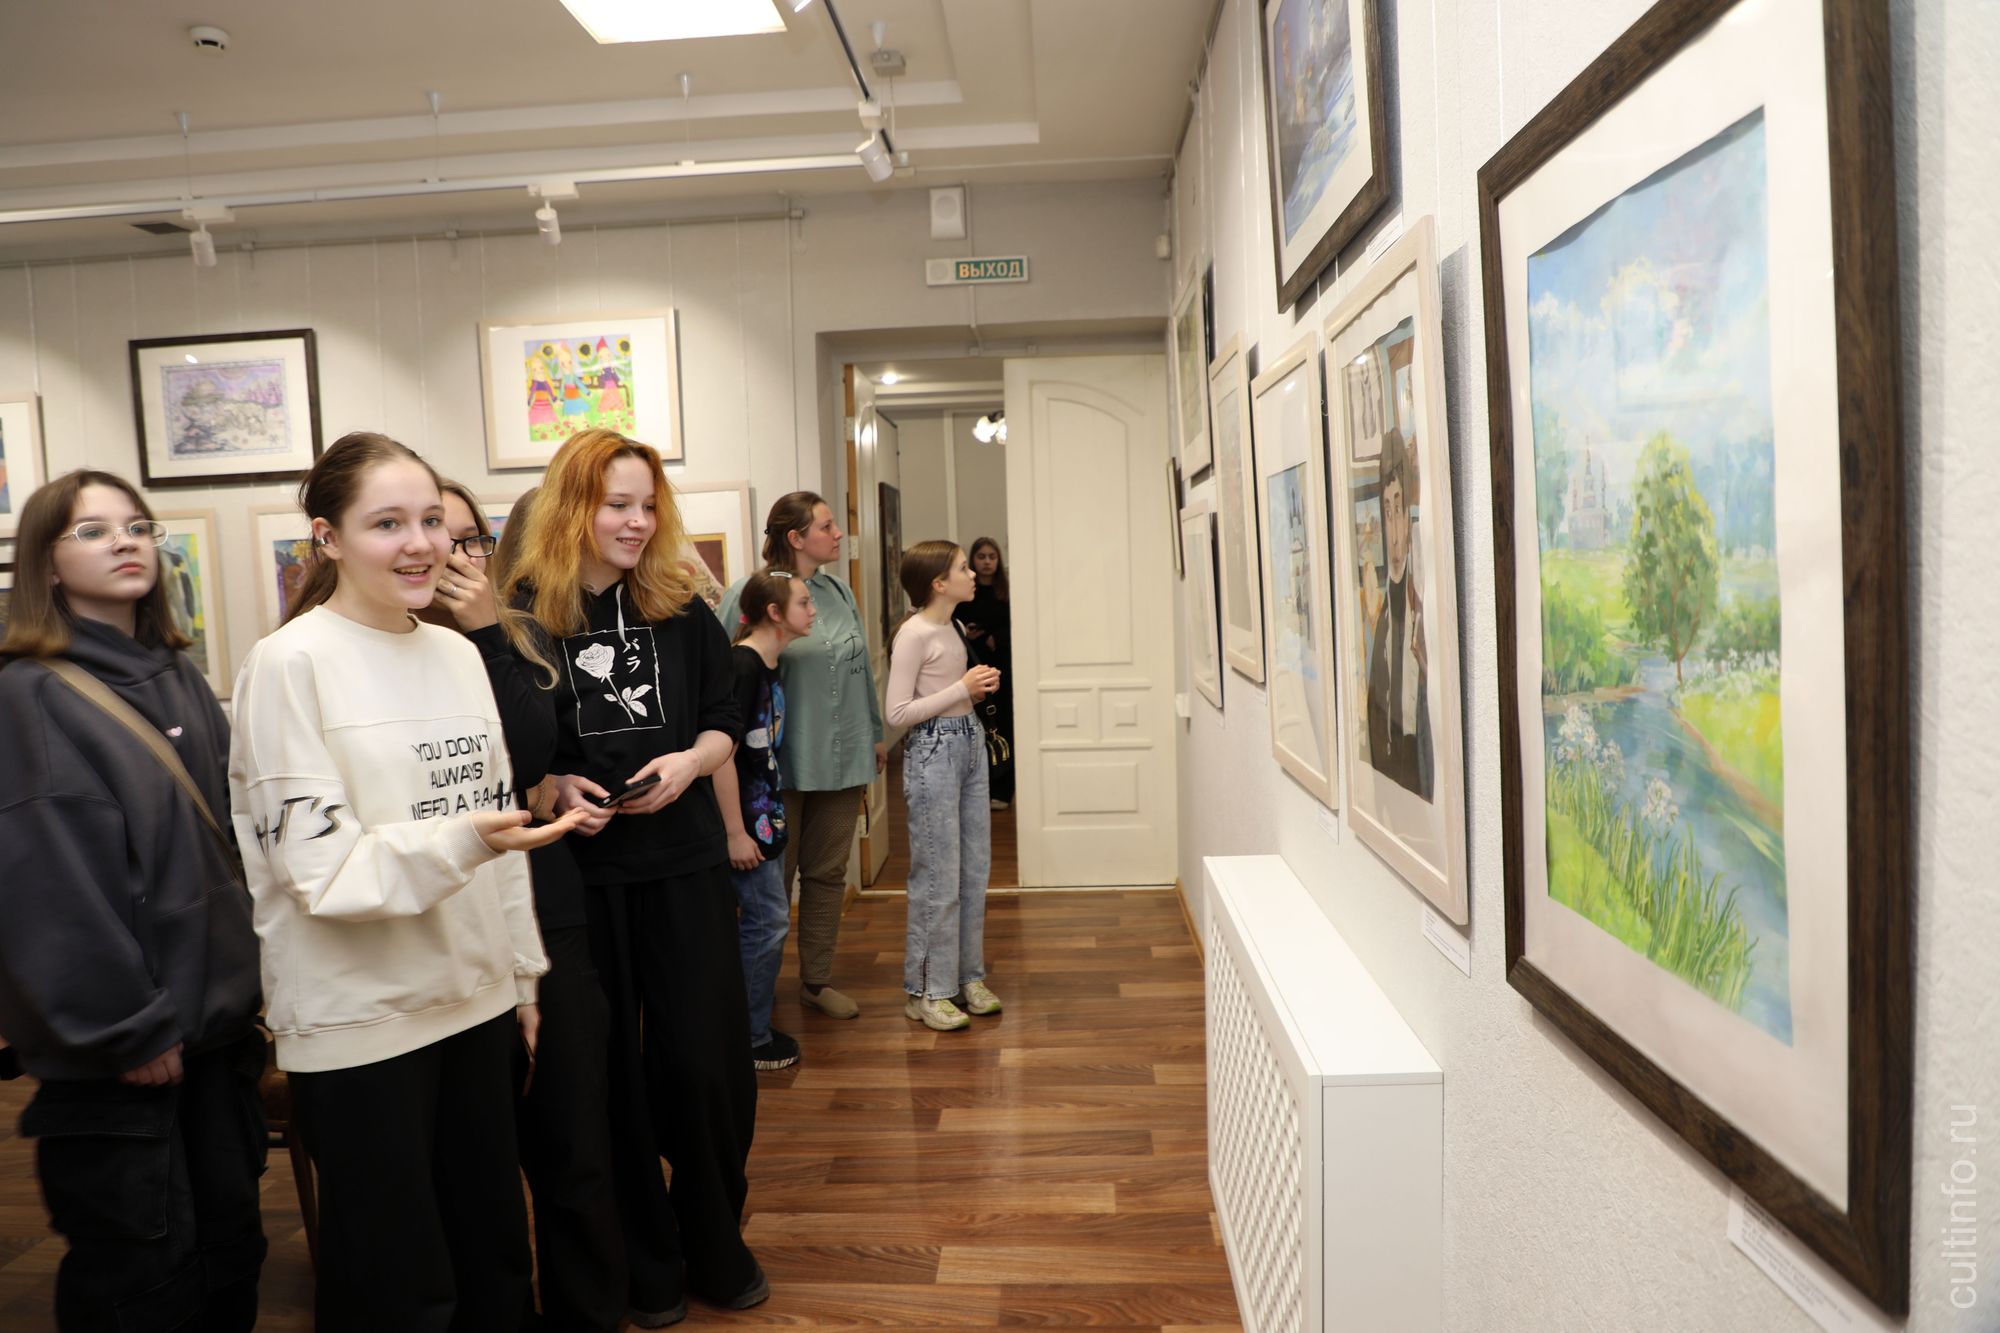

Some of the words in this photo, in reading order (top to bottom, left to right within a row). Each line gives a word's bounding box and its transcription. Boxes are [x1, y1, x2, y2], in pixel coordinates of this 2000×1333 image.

[959, 261, 1021, 279] ВЫХОД
[411, 741, 442, 761] YOU
[445, 734, 490, 758] DON'T
[431, 761, 484, 789] ALWAYS
[411, 797, 449, 821] NEED
[456, 793, 470, 814] A
